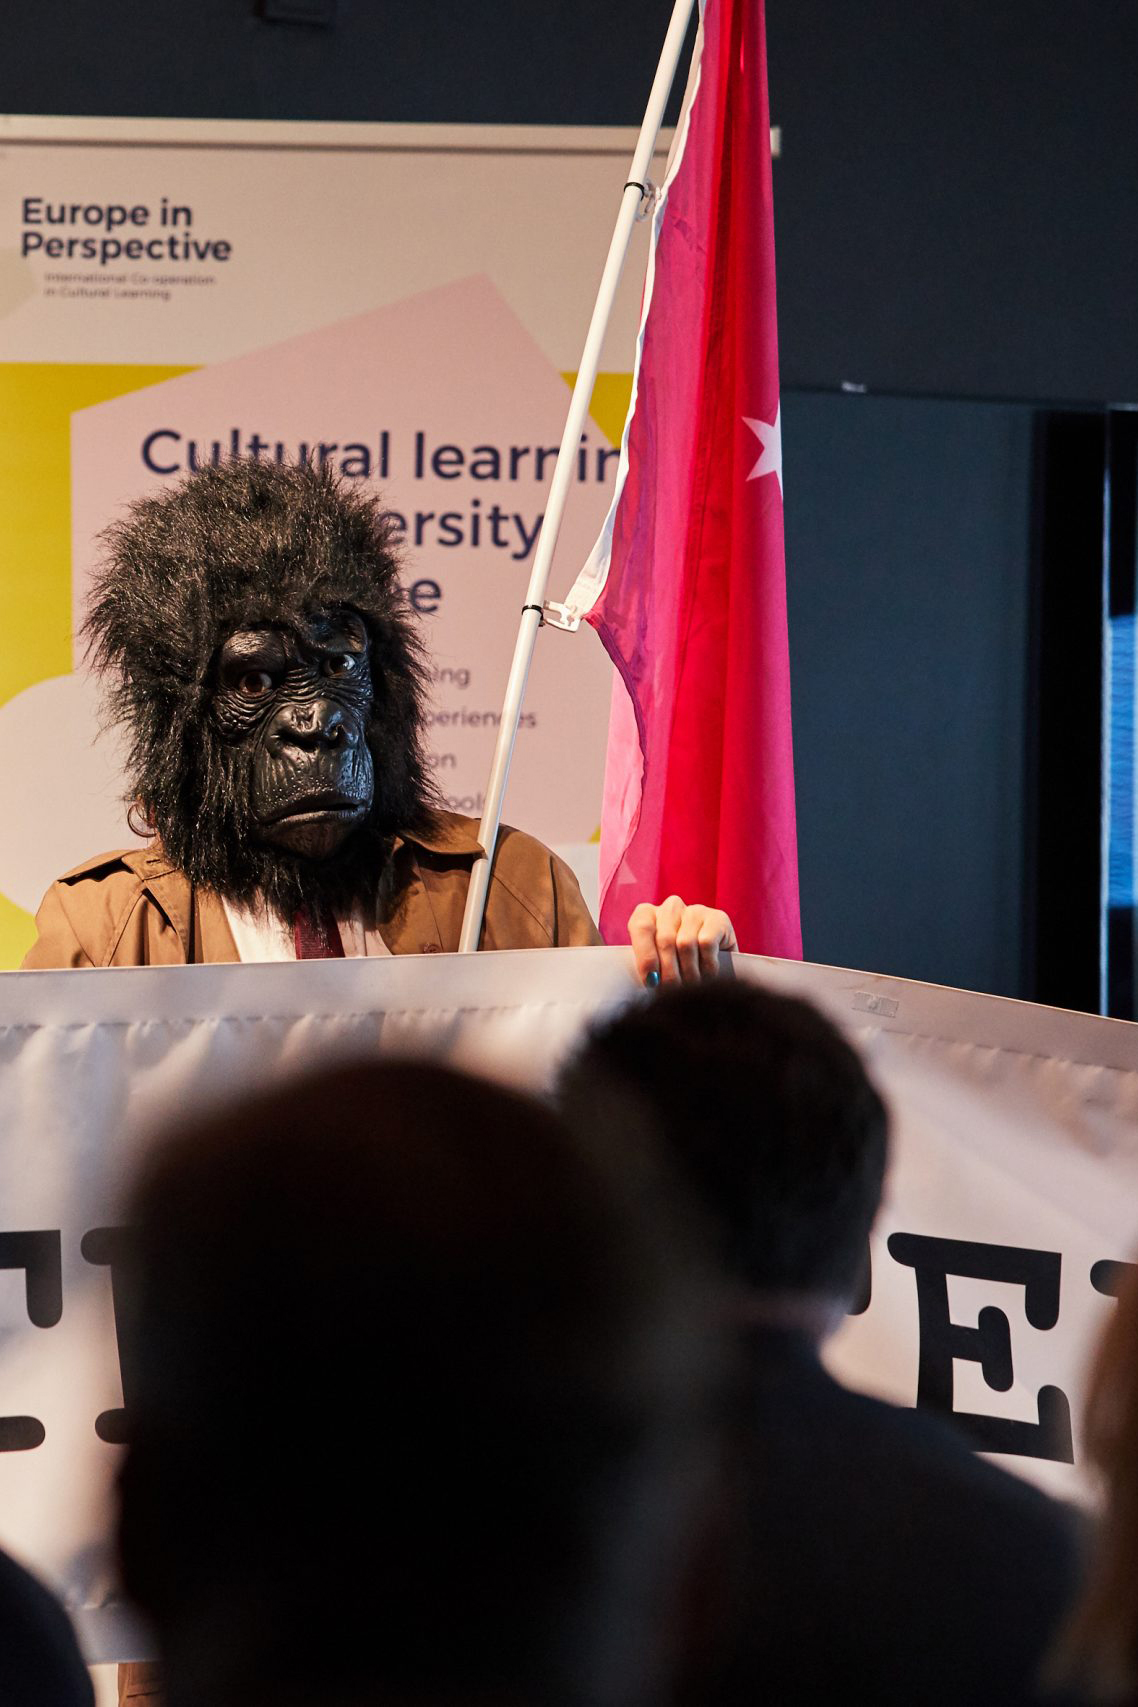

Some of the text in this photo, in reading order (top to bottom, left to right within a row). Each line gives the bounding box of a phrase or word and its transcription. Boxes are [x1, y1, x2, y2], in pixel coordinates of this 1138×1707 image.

[21, 198, 193, 231] Europe in
[21, 231, 232, 265] Perspective
[44, 272, 127, 284] International
[60, 286, 111, 299] Cultural
[114, 287, 171, 301] Learning
[414, 431, 622, 483] learnin
[376, 498, 547, 560] ersity
